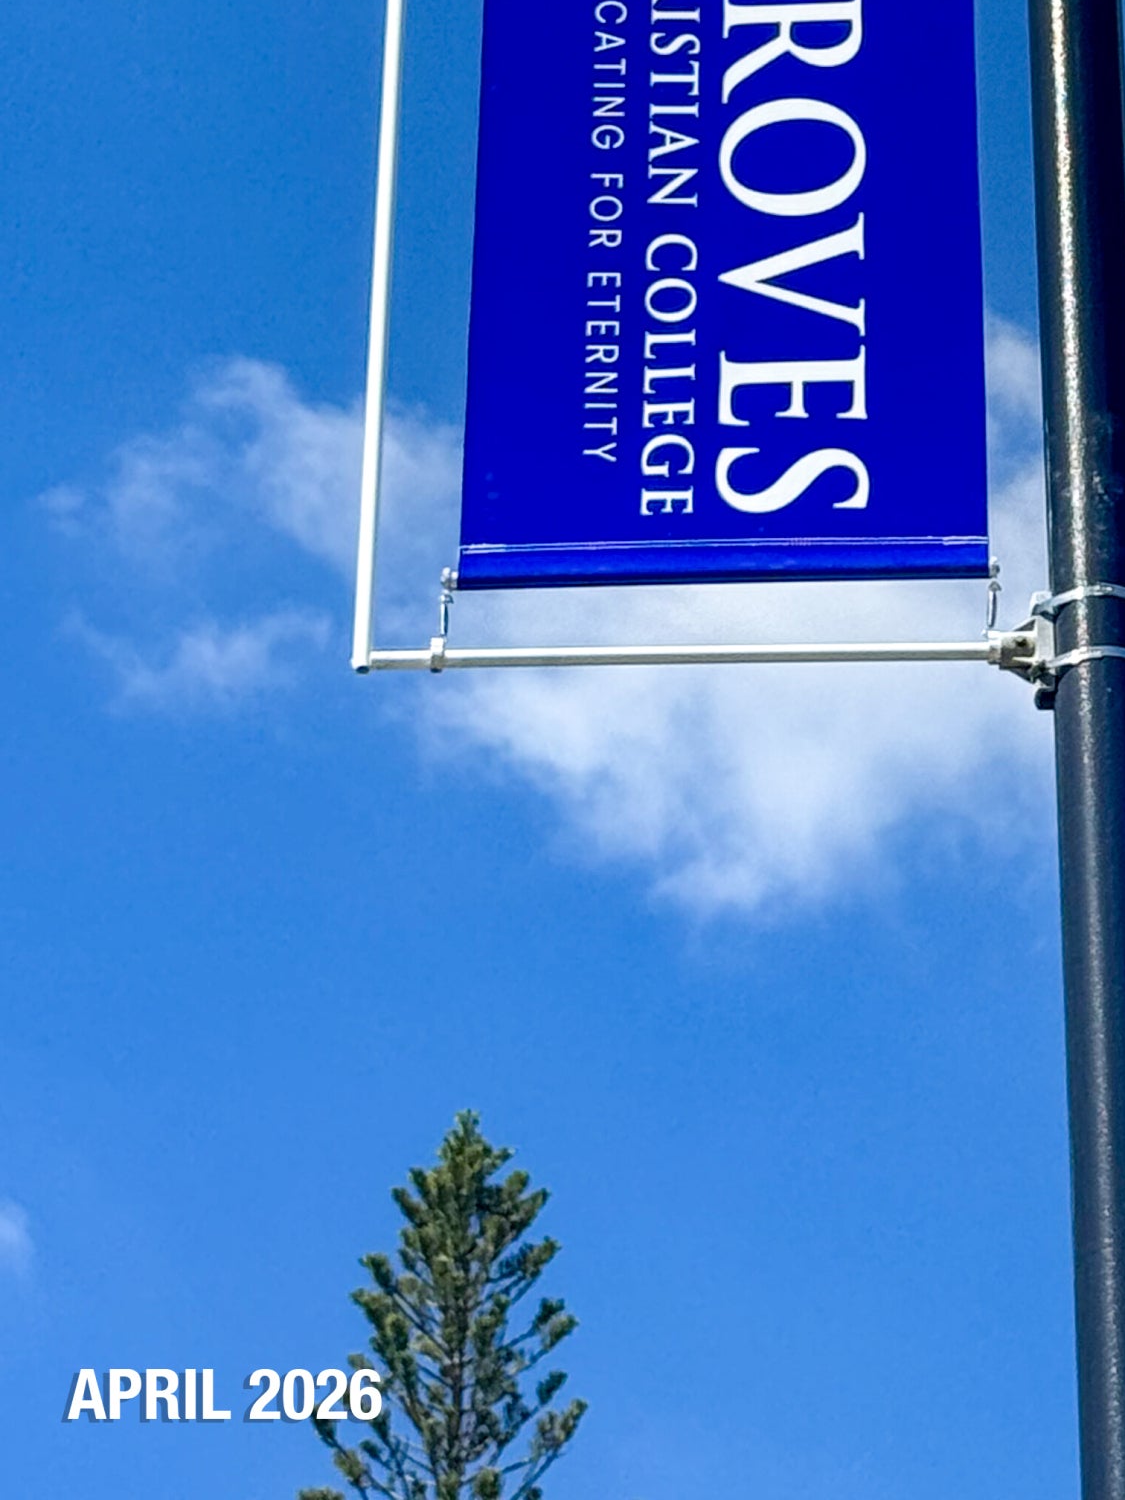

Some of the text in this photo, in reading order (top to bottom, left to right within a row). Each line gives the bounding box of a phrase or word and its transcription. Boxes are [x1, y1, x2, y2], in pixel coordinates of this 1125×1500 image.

[589, 173, 624, 248] FOR
[583, 272, 621, 462] ETERNITY
[640, 233, 698, 516] COLLEGE
